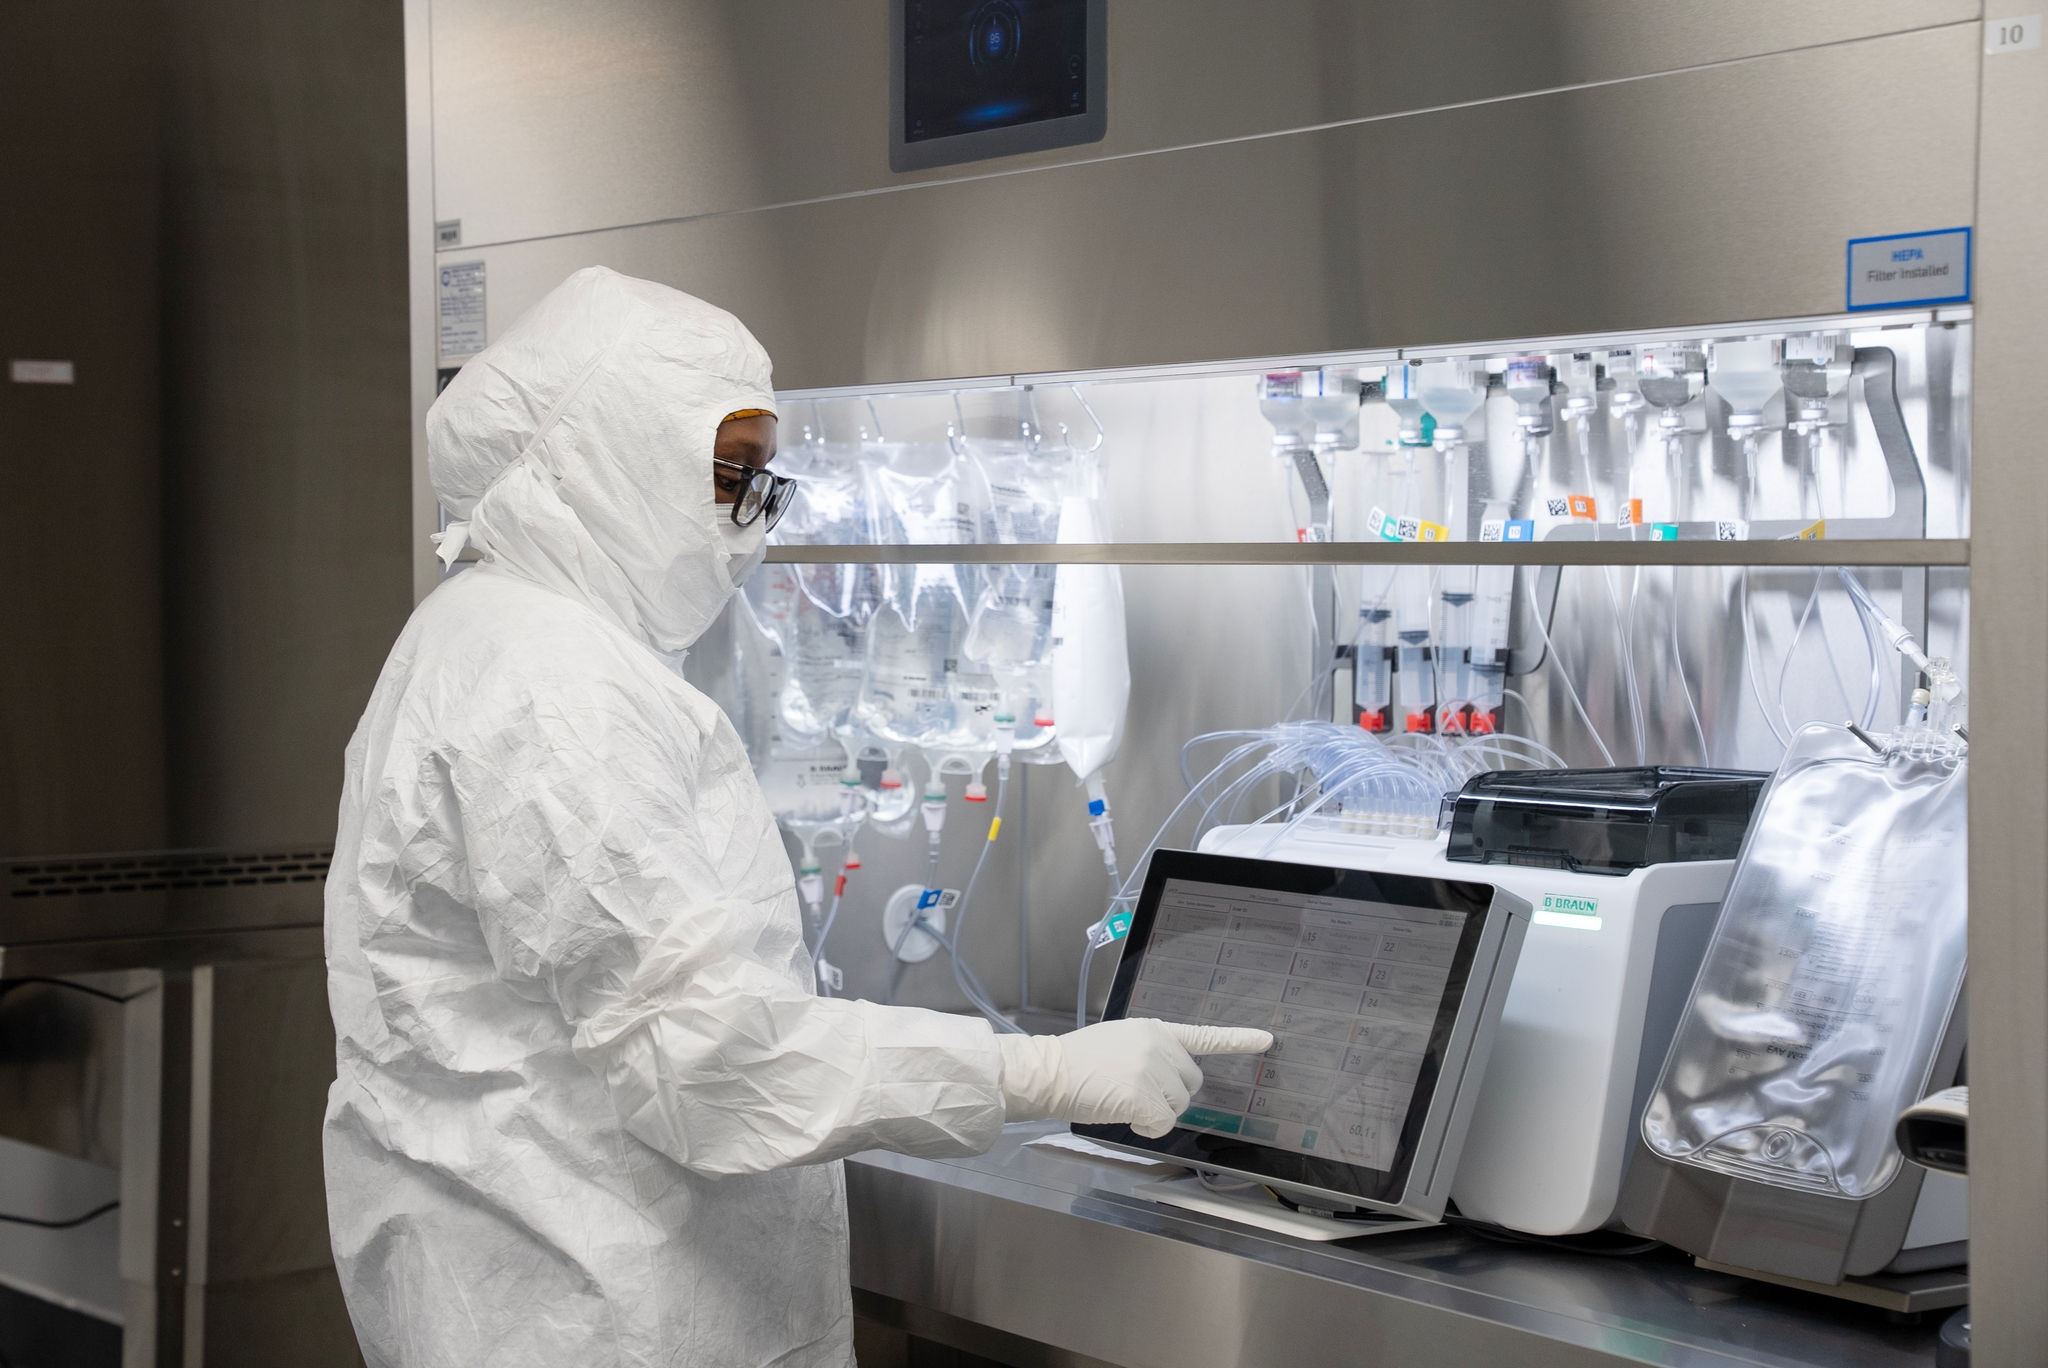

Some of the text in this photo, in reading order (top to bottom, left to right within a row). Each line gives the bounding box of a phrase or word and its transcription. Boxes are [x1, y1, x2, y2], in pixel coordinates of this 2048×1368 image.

[2000, 24, 2024, 45] 10
[1868, 264, 1949, 281] Filter Installed
[1544, 897, 1595, 911] B BRAUN
[1307, 932, 1317, 942] 15
[1384, 942, 1395, 952] 22
[1375, 970, 1386, 980] 23
[1218, 976, 1227, 985] 10
[1291, 987, 1300, 997] 17
[1367, 998, 1378, 1008] 24
[1351, 1055, 1361, 1065] 26
[1264, 1069, 1275, 1079] 20
[1256, 1096, 1266, 1107] 21
